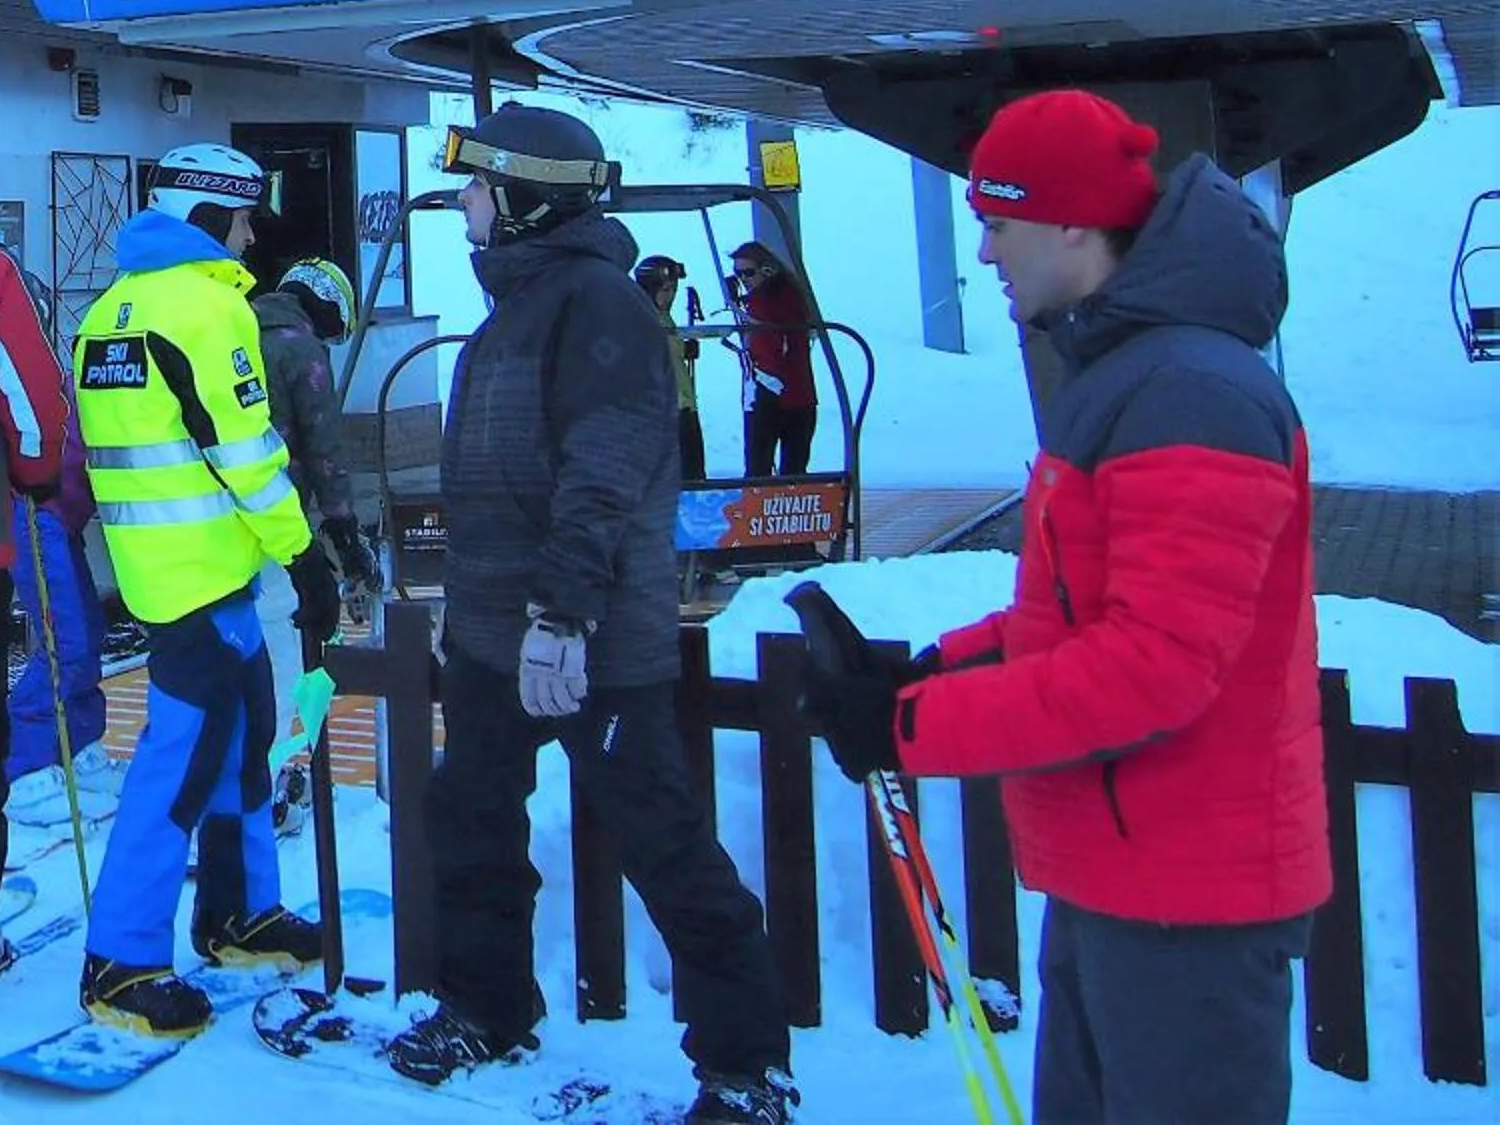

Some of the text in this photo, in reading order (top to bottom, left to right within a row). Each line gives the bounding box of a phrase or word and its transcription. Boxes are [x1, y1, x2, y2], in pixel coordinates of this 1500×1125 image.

[174, 172, 264, 195] BLIZZARD
[105, 342, 129, 363] SKI
[85, 362, 145, 385] PATROL
[749, 512, 832, 537] SI STABILITU
